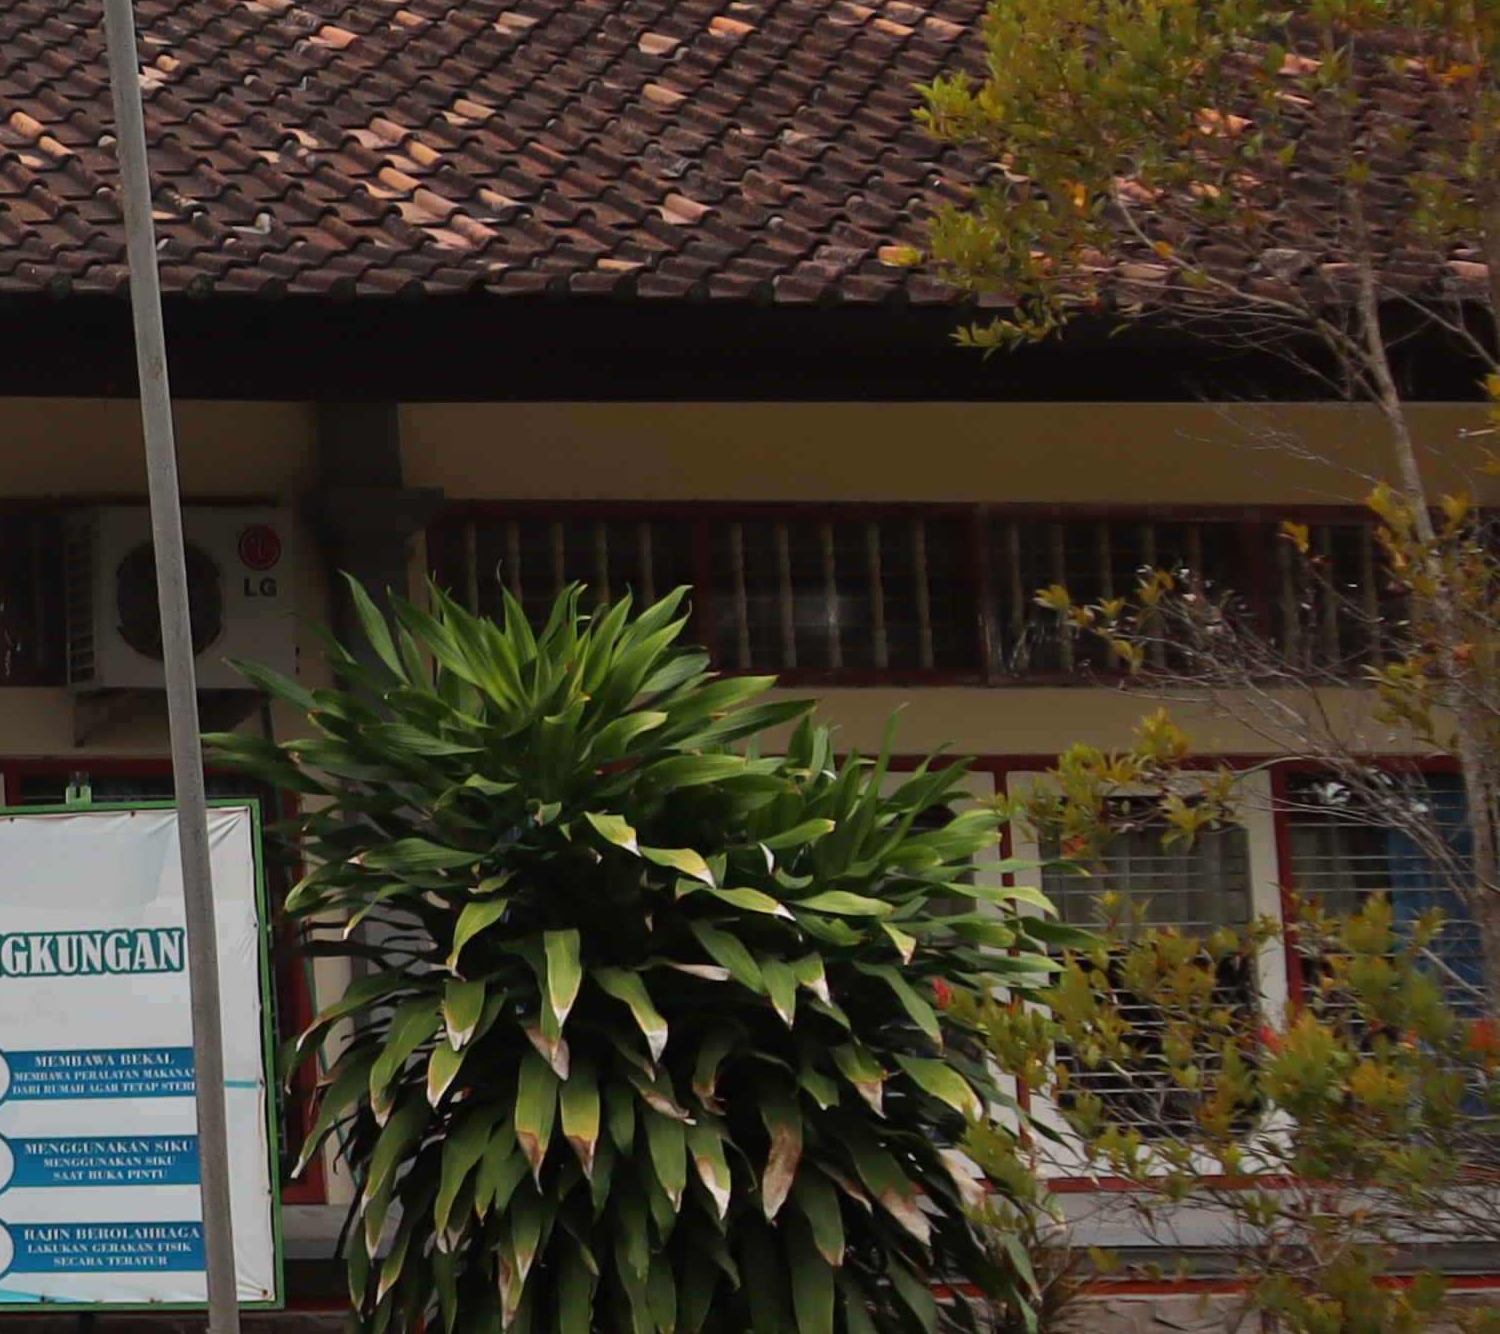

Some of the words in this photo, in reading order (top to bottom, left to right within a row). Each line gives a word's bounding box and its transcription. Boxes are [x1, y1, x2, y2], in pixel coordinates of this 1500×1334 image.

[244, 577, 277, 597] LG
[34, 1055, 115, 1067] MEMBAWA
[121, 1053, 174, 1065] BEKAL
[14, 1071, 71, 1081] MEMBAWA
[74, 1070, 139, 1081] PERALATAN
[12, 1085, 40, 1095] DARI
[43, 1084, 84, 1094] RUMAH
[88, 1083, 118, 1093] AGAR
[122, 1083, 158, 1092] TETAP
[161, 1082, 195, 1091] STERI
[24, 1142, 150, 1154] MENGGUNAKAN
[155, 1140, 193, 1152] SIKU
[43, 1157, 142, 1167] MENGGUNAKAN
[145, 1156, 176, 1166] SIKU
[53, 1171, 84, 1180] SAAT
[88, 1170, 124, 1180] BUKA
[127, 1170, 168, 1179] PINTU
[24, 1229, 70, 1241] RAJIN
[76, 1227, 199, 1240] BEROLAHRAGA
[27, 1244, 88, 1253] LAKUKAN
[92, 1243, 154, 1253] GERAKAN
[158, 1243, 191, 1252] FISIK
[53, 1257, 103, 1266] SECARA
[106, 1256, 168, 1265] TERATUR
